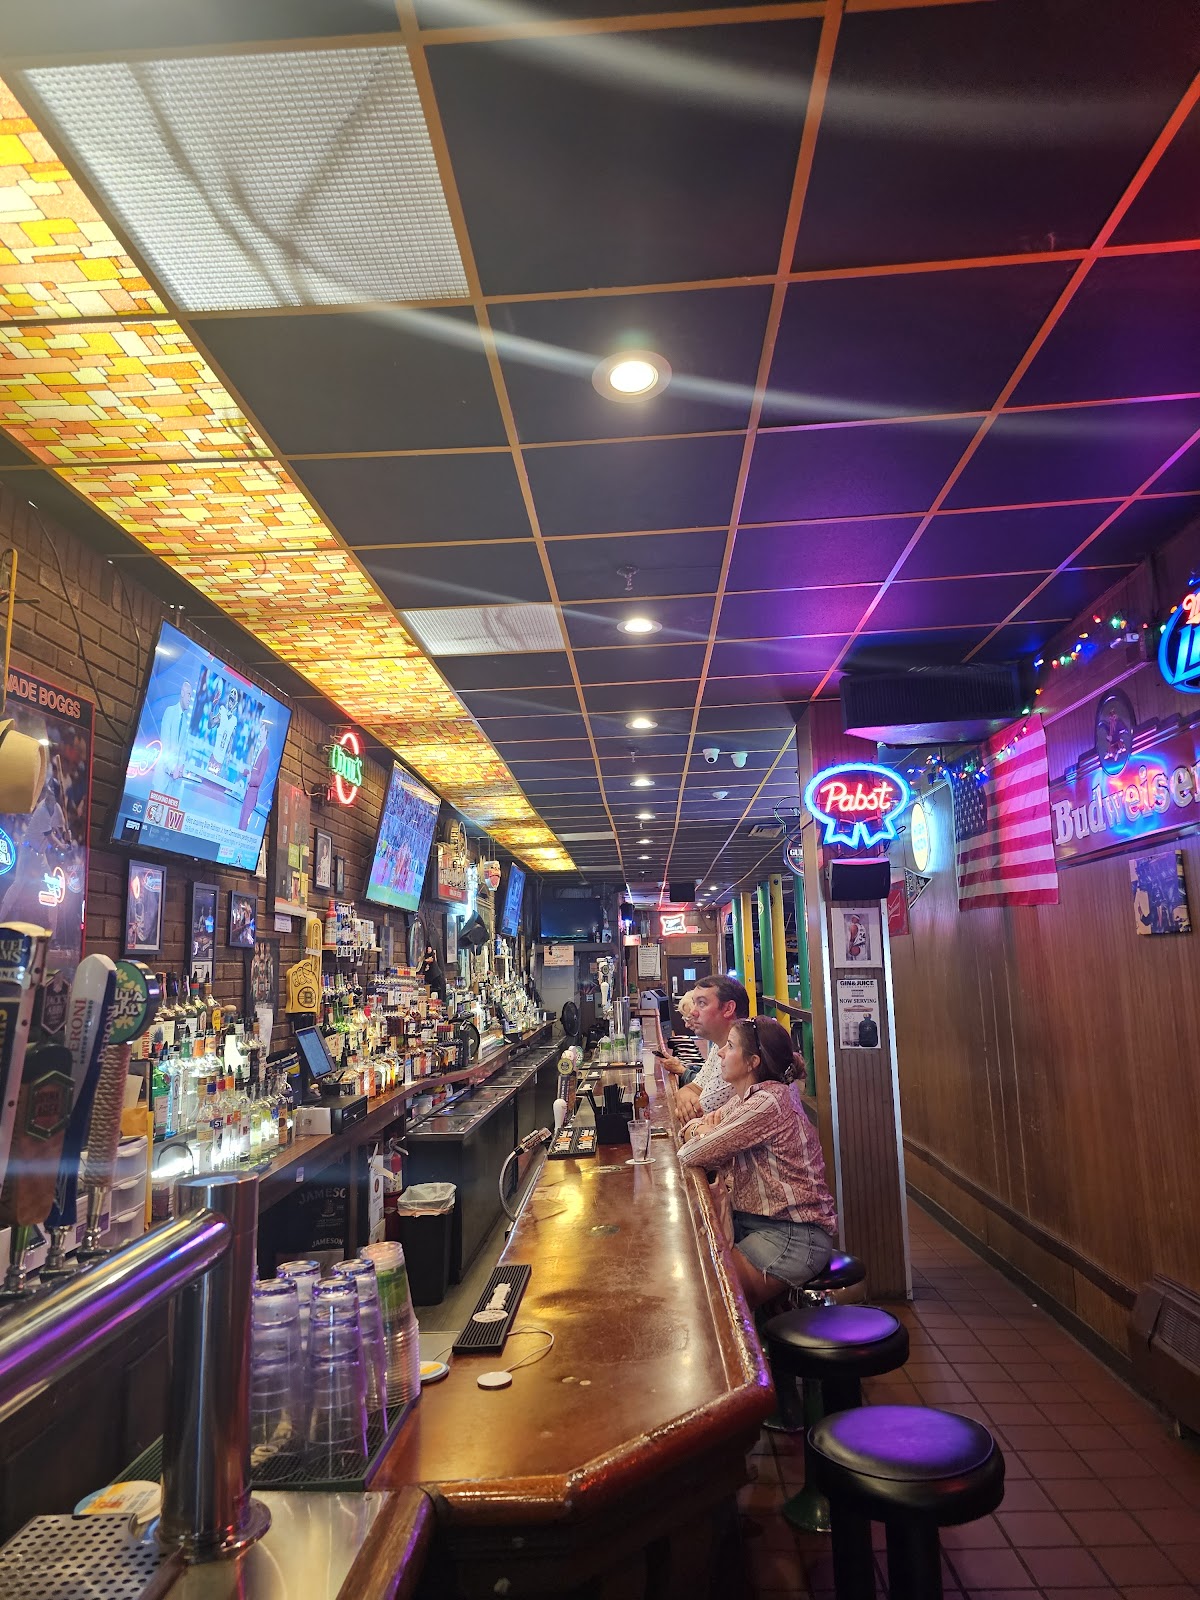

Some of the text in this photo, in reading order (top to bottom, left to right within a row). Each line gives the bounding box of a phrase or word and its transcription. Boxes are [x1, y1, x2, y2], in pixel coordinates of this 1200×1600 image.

[38, 686, 81, 719] BOGGS
[820, 781, 894, 813] Pabst
[125, 820, 140, 831] ESPN
[69, 998, 88, 1064] ERONI
[311, 1237, 344, 1248] JAMESON
